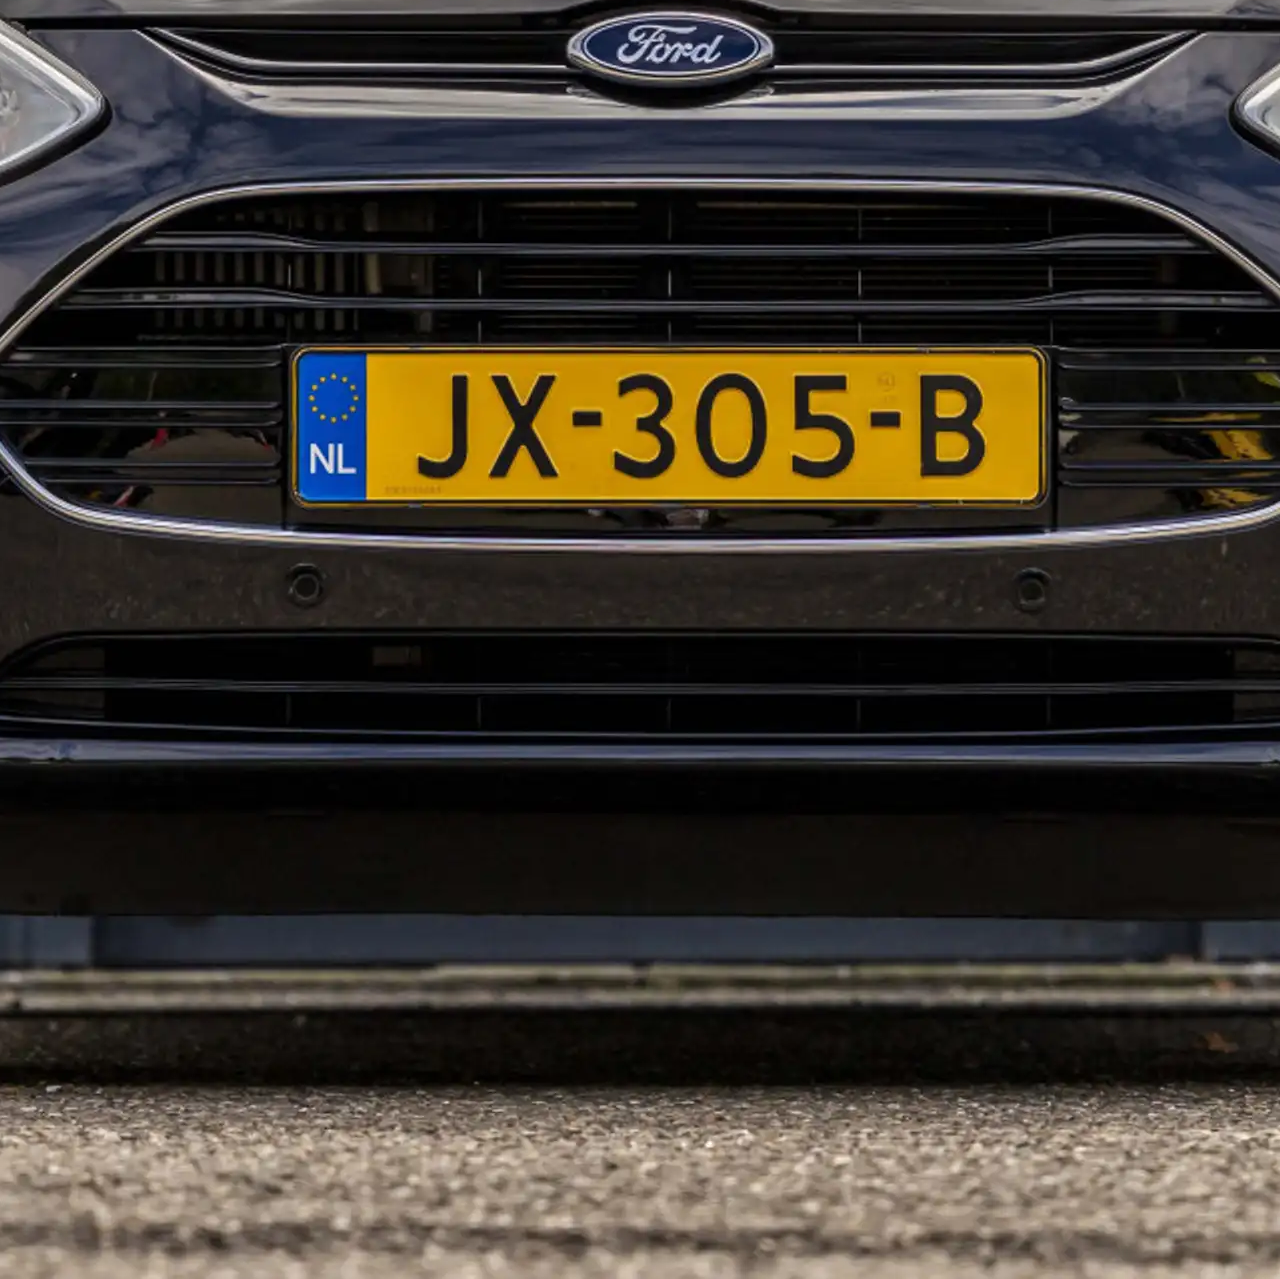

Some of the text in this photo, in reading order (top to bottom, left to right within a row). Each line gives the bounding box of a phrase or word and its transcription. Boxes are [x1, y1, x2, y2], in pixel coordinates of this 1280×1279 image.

[617, 24, 722, 65] Ford
[416, 373, 987, 479] JX-305-B
[309, 443, 357, 475] NL
